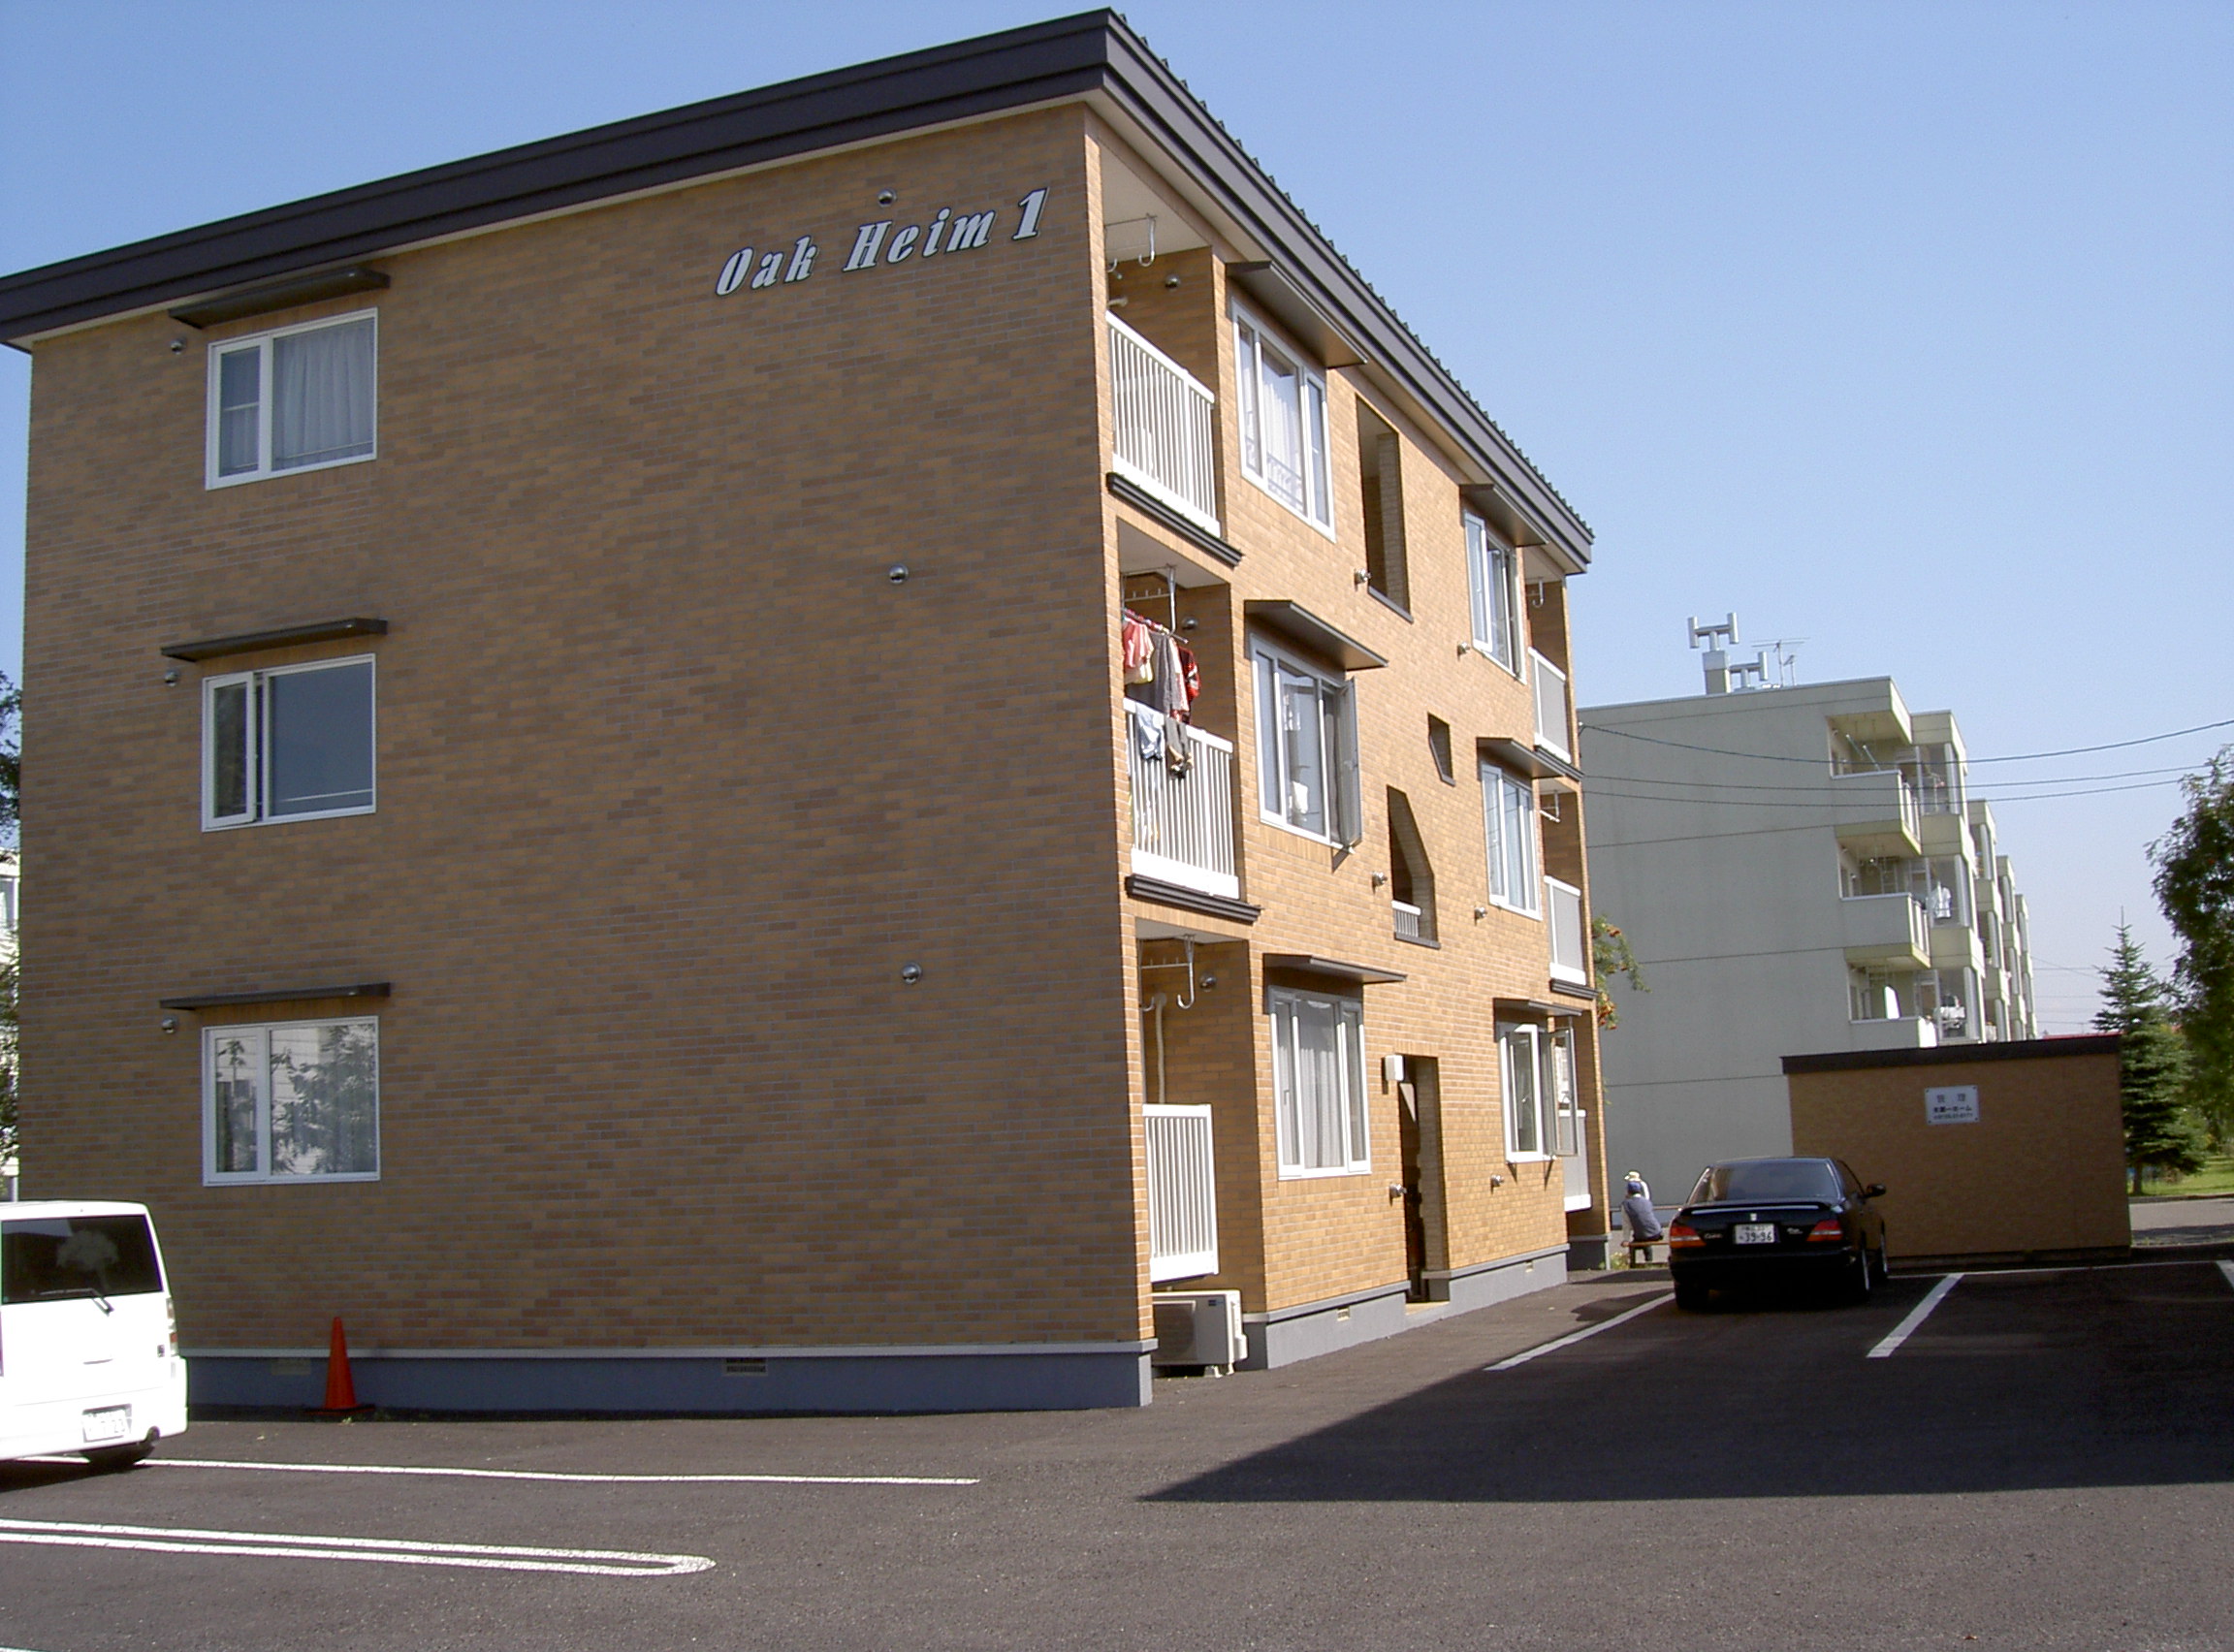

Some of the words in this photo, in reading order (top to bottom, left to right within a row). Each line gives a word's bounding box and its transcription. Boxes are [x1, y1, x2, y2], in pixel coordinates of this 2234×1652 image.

[716, 235, 817, 297] Oak
[842, 206, 996, 272] Heim
[1011, 186, 1049, 240] 1
